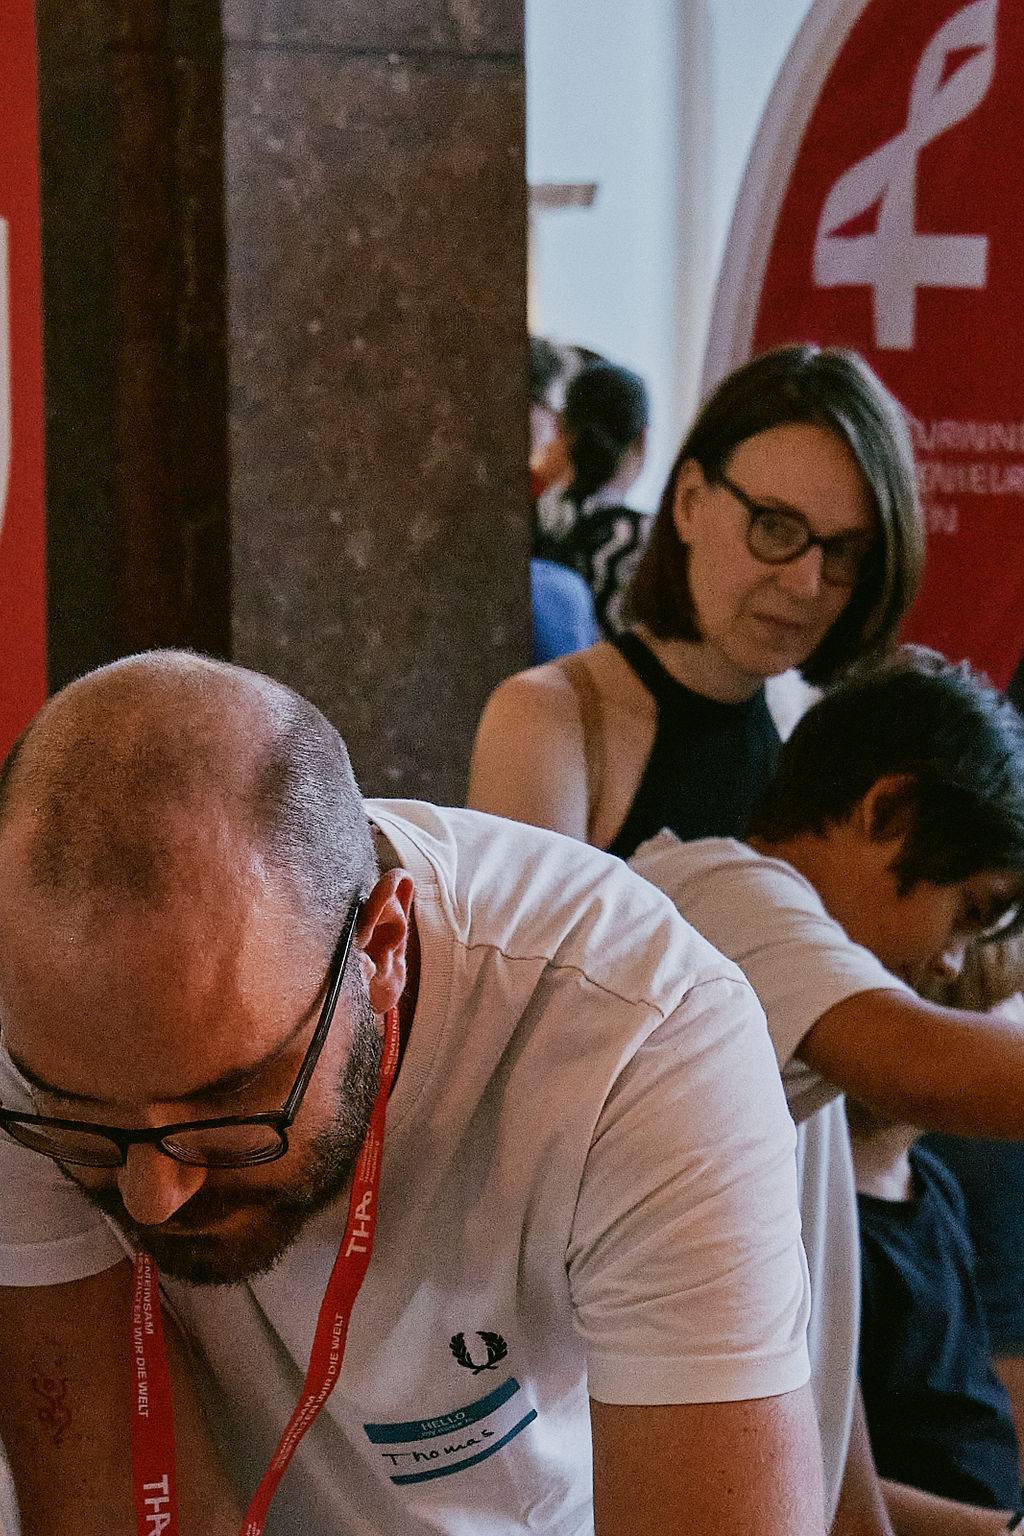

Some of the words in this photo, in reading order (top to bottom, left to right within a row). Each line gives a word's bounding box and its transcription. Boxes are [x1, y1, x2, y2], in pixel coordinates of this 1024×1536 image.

[134, 1326, 144, 1354] WIR
[331, 1312, 344, 1350] WELT
[136, 1357, 147, 1379] DIE
[329, 1352, 340, 1376] DIE
[137, 1381, 149, 1418] WELT
[421, 1411, 466, 1431] HELLO
[382, 1429, 495, 1465] Thomas
